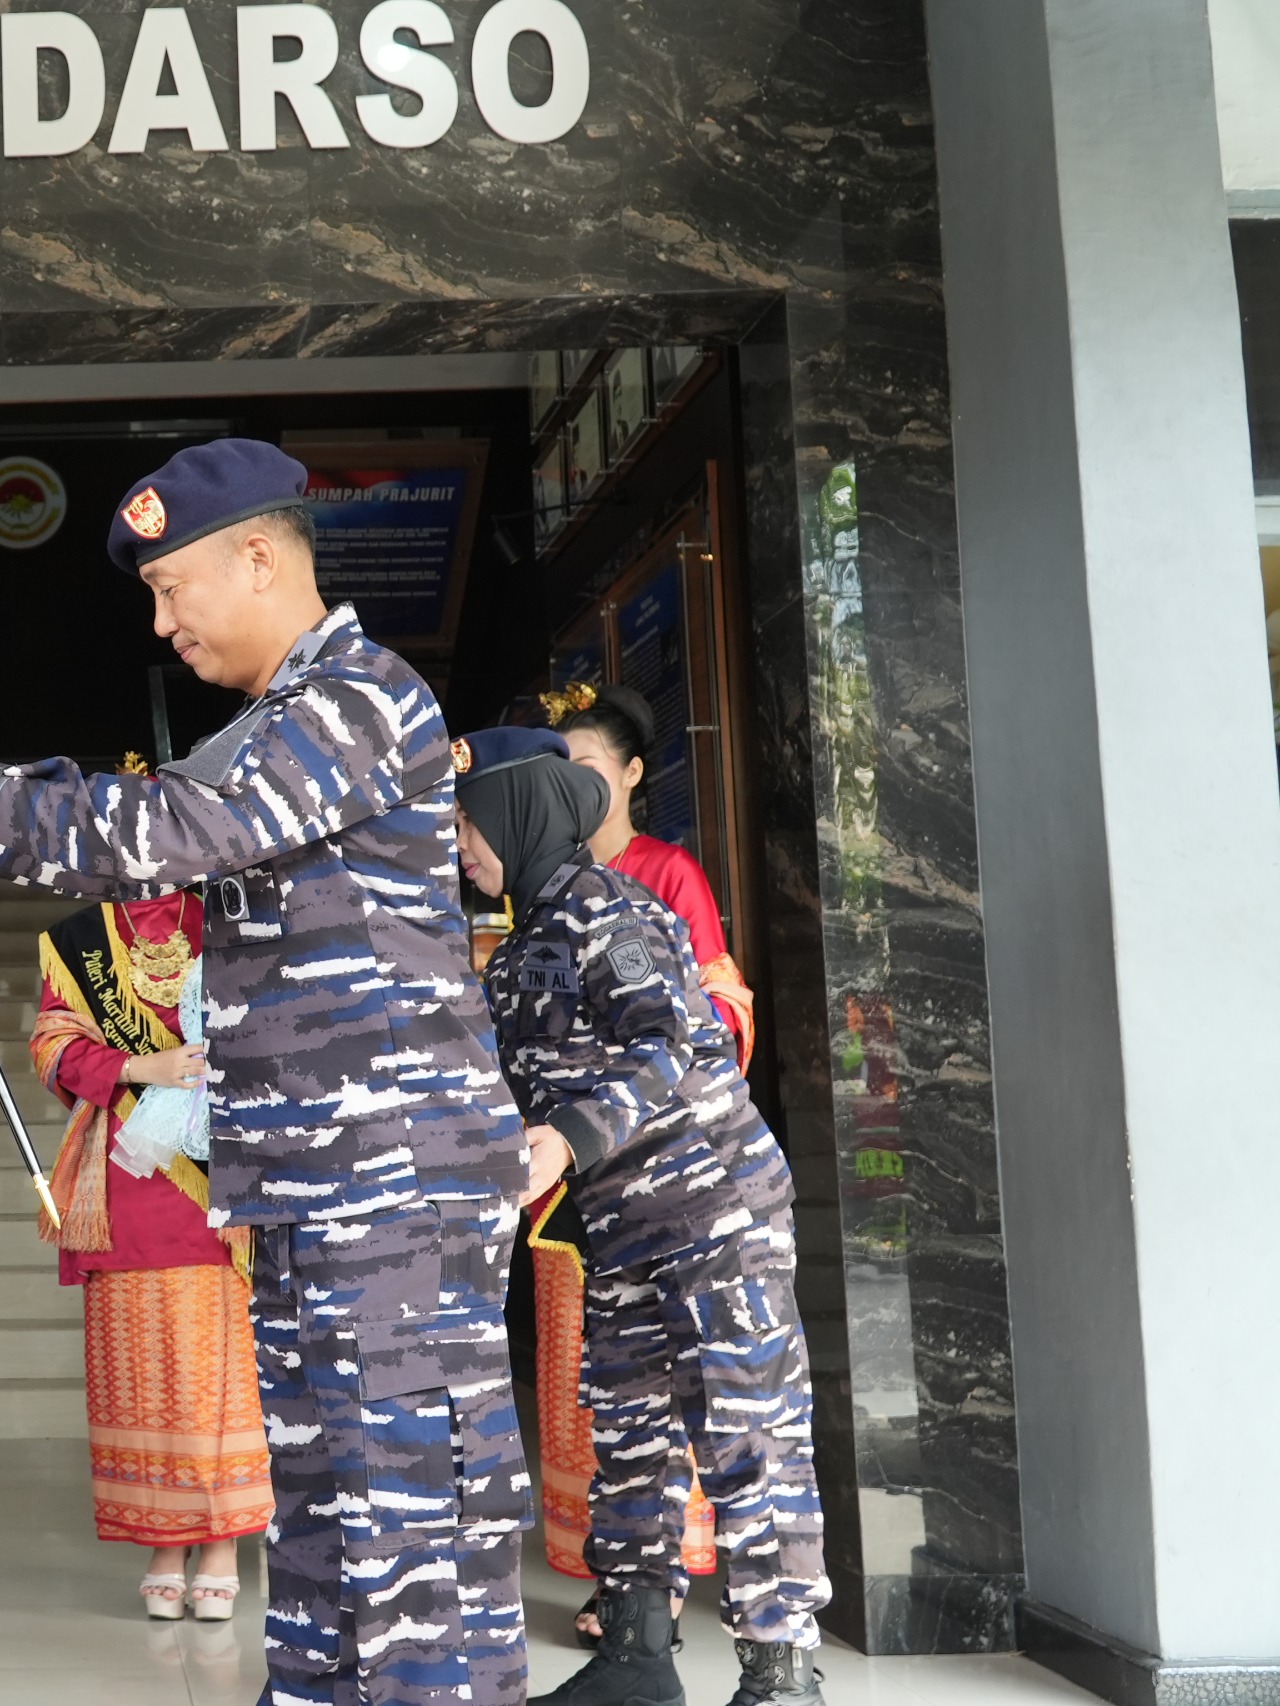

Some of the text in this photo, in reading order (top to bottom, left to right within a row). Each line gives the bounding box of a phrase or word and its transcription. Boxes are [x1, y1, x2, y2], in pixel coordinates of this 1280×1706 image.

[308, 486, 455, 501] SUMPAH PRAJURIT
[82, 950, 108, 990] Puteri
[527, 970, 570, 990] TNI AL
